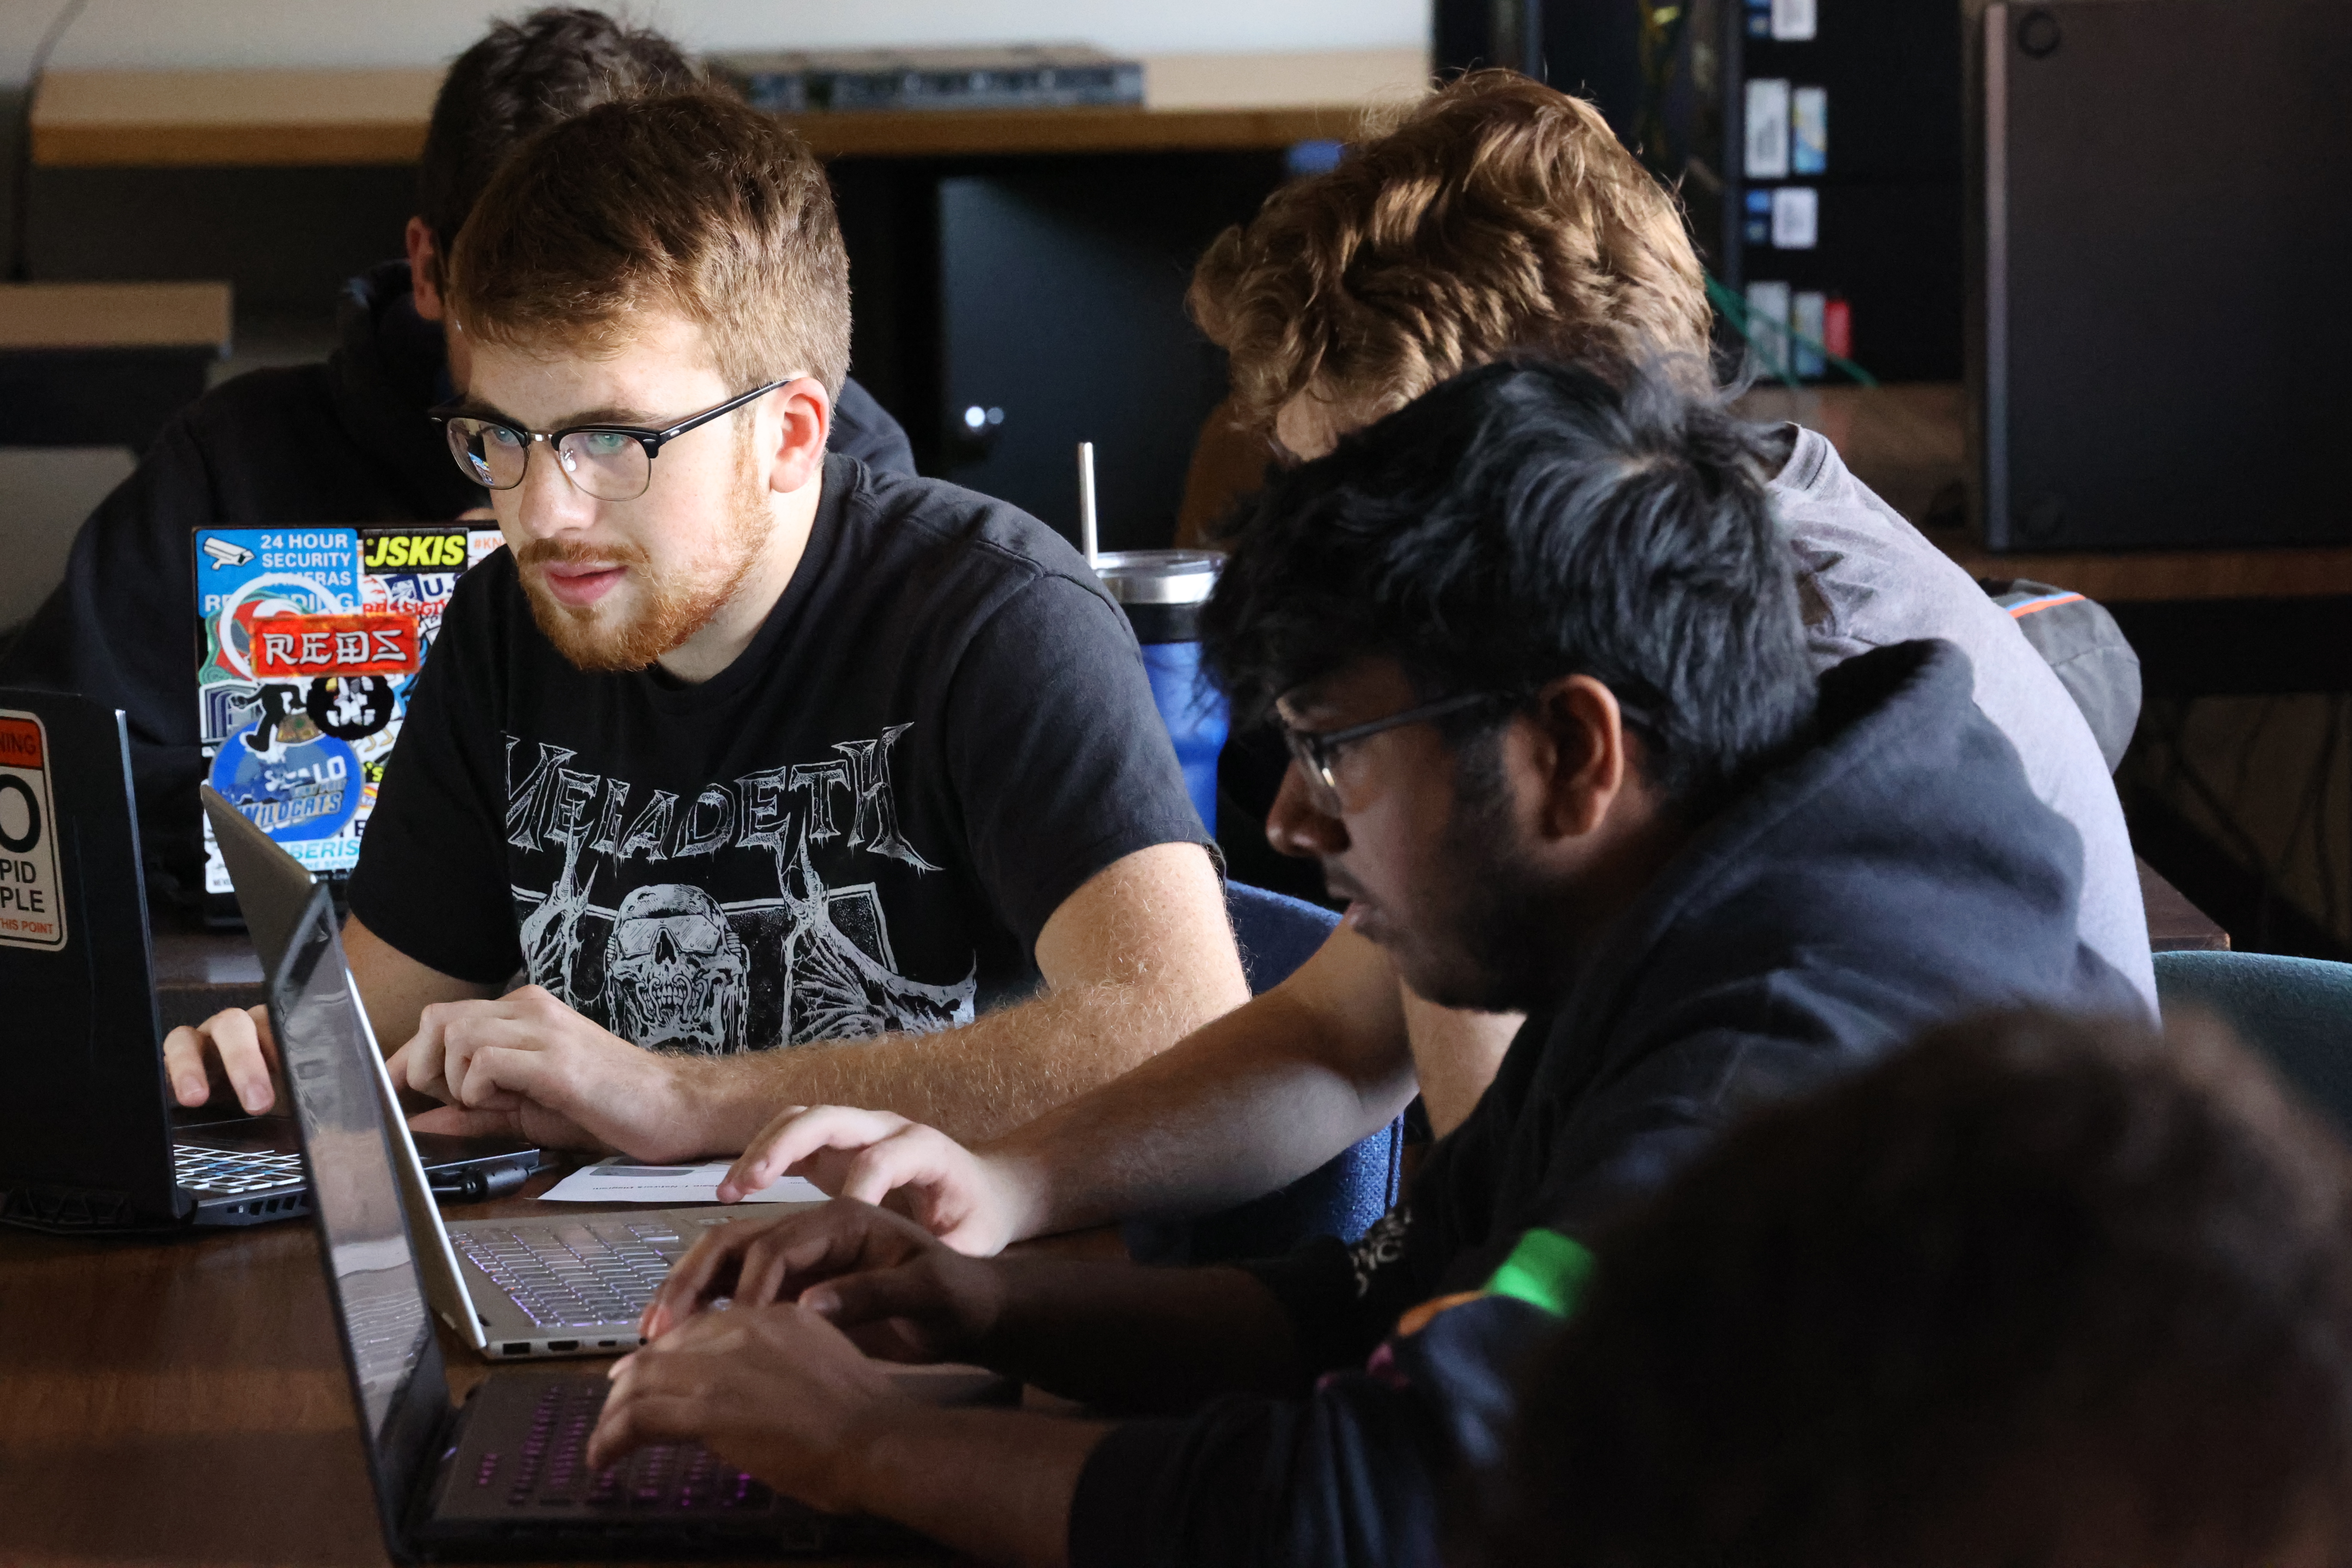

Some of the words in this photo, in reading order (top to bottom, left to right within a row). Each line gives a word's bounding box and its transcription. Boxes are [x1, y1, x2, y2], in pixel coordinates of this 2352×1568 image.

[261, 535, 284, 549] 24
[288, 533, 348, 549] HOUR
[262, 552, 351, 568] SECURITY
[262, 630, 407, 665] REDS
[0, 859, 36, 883] PID
[0, 887, 45, 913] PLE
[21, 920, 53, 934] POINT
